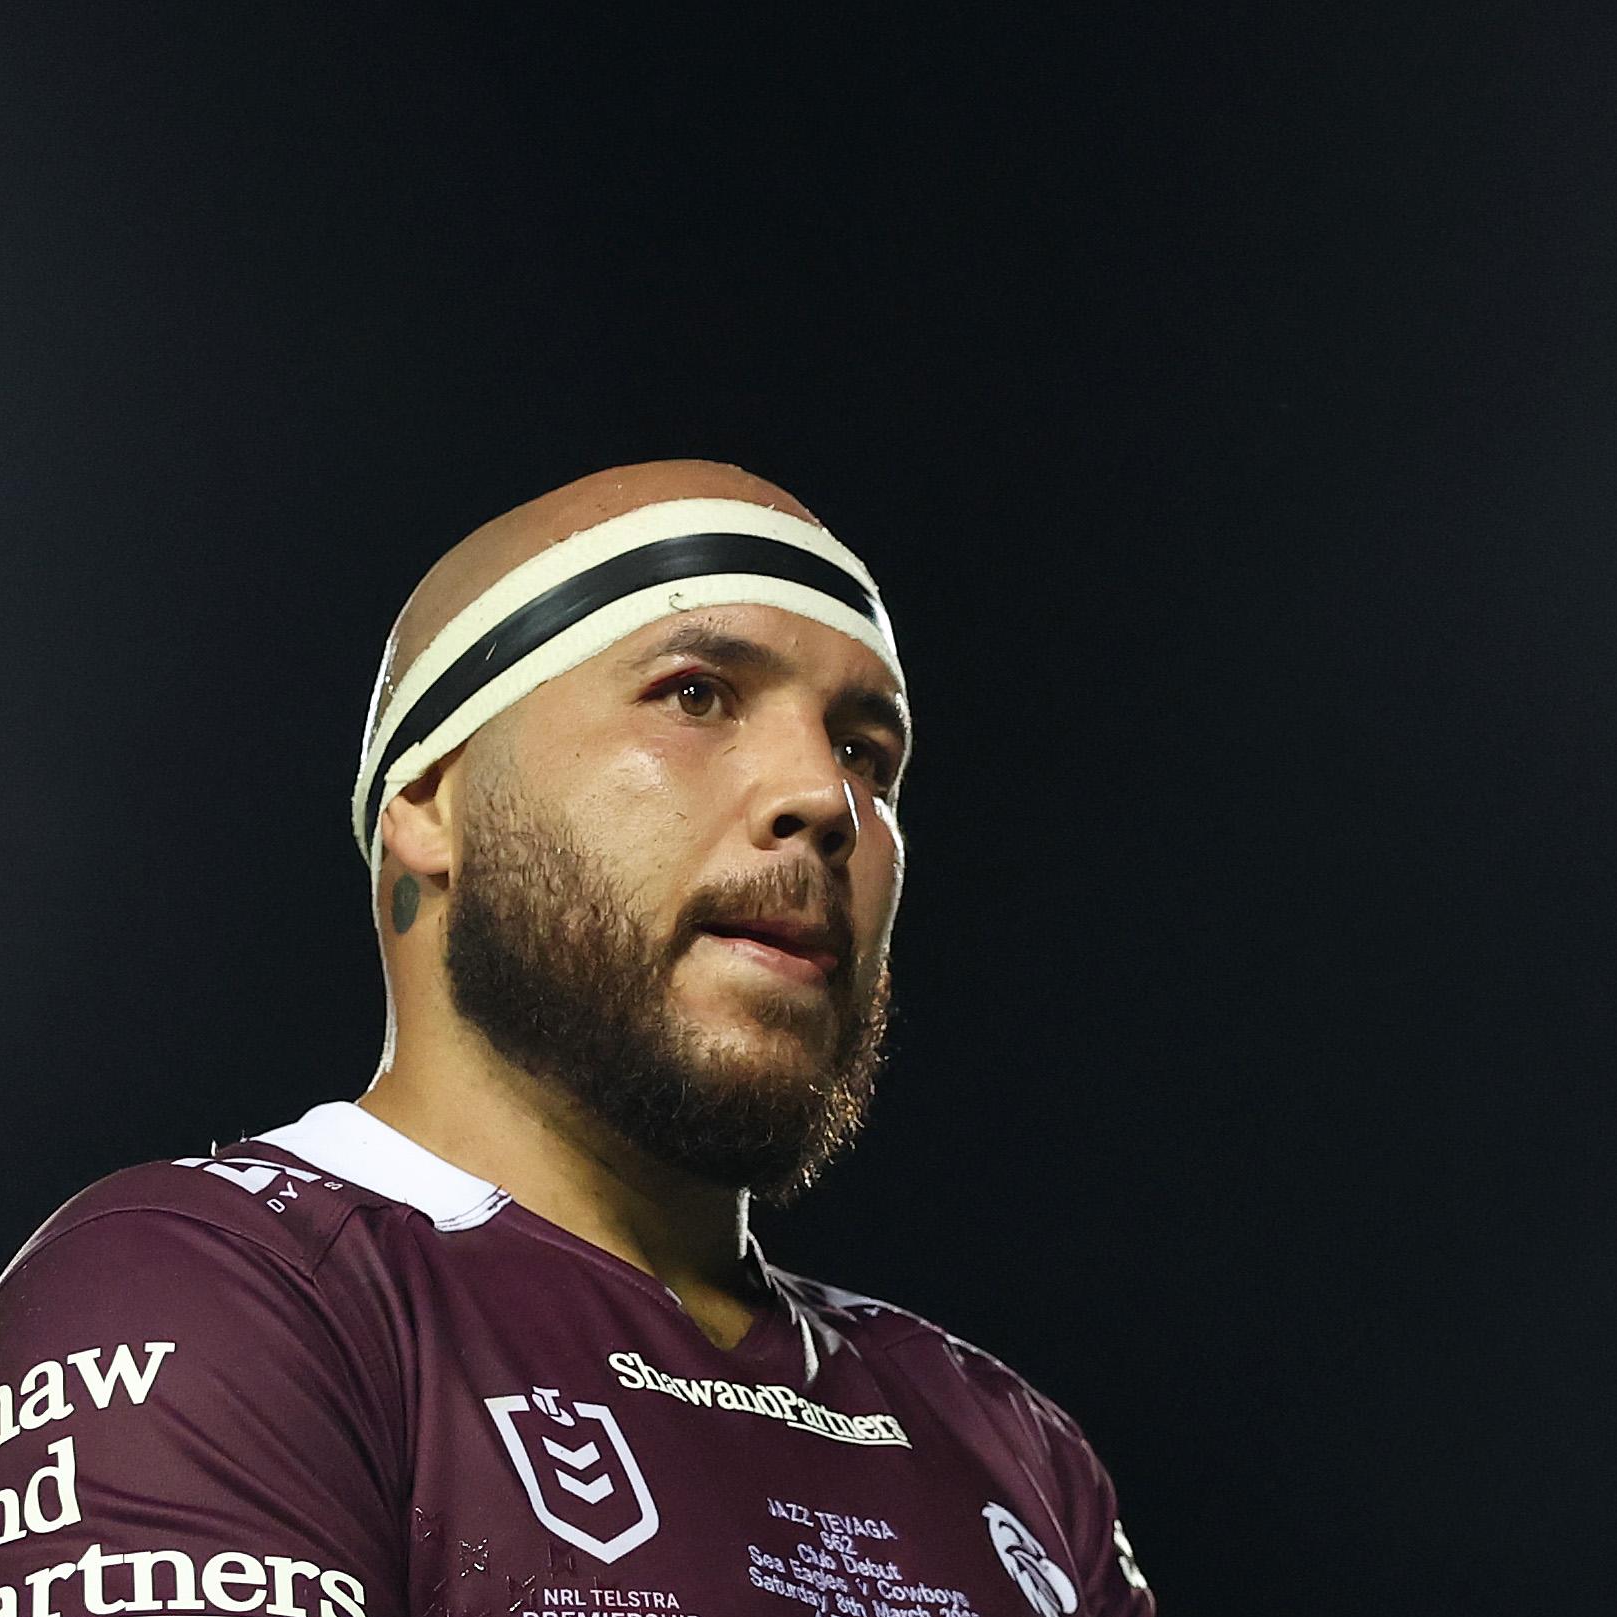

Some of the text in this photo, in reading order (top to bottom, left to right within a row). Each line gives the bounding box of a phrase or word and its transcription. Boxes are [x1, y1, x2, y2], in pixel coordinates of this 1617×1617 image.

[814, 1511, 899, 1541] TEVAGA
[819, 1530, 859, 1556] 662
[747, 1544, 787, 1574] Sea
[788, 1557, 850, 1593] Eagles
[876, 1579, 971, 1610] Cowboys
[796, 1543, 904, 1581] Club Debut
[543, 1588, 681, 1610] NRL TELSTRA
[748, 1566, 828, 1613] Saturday
